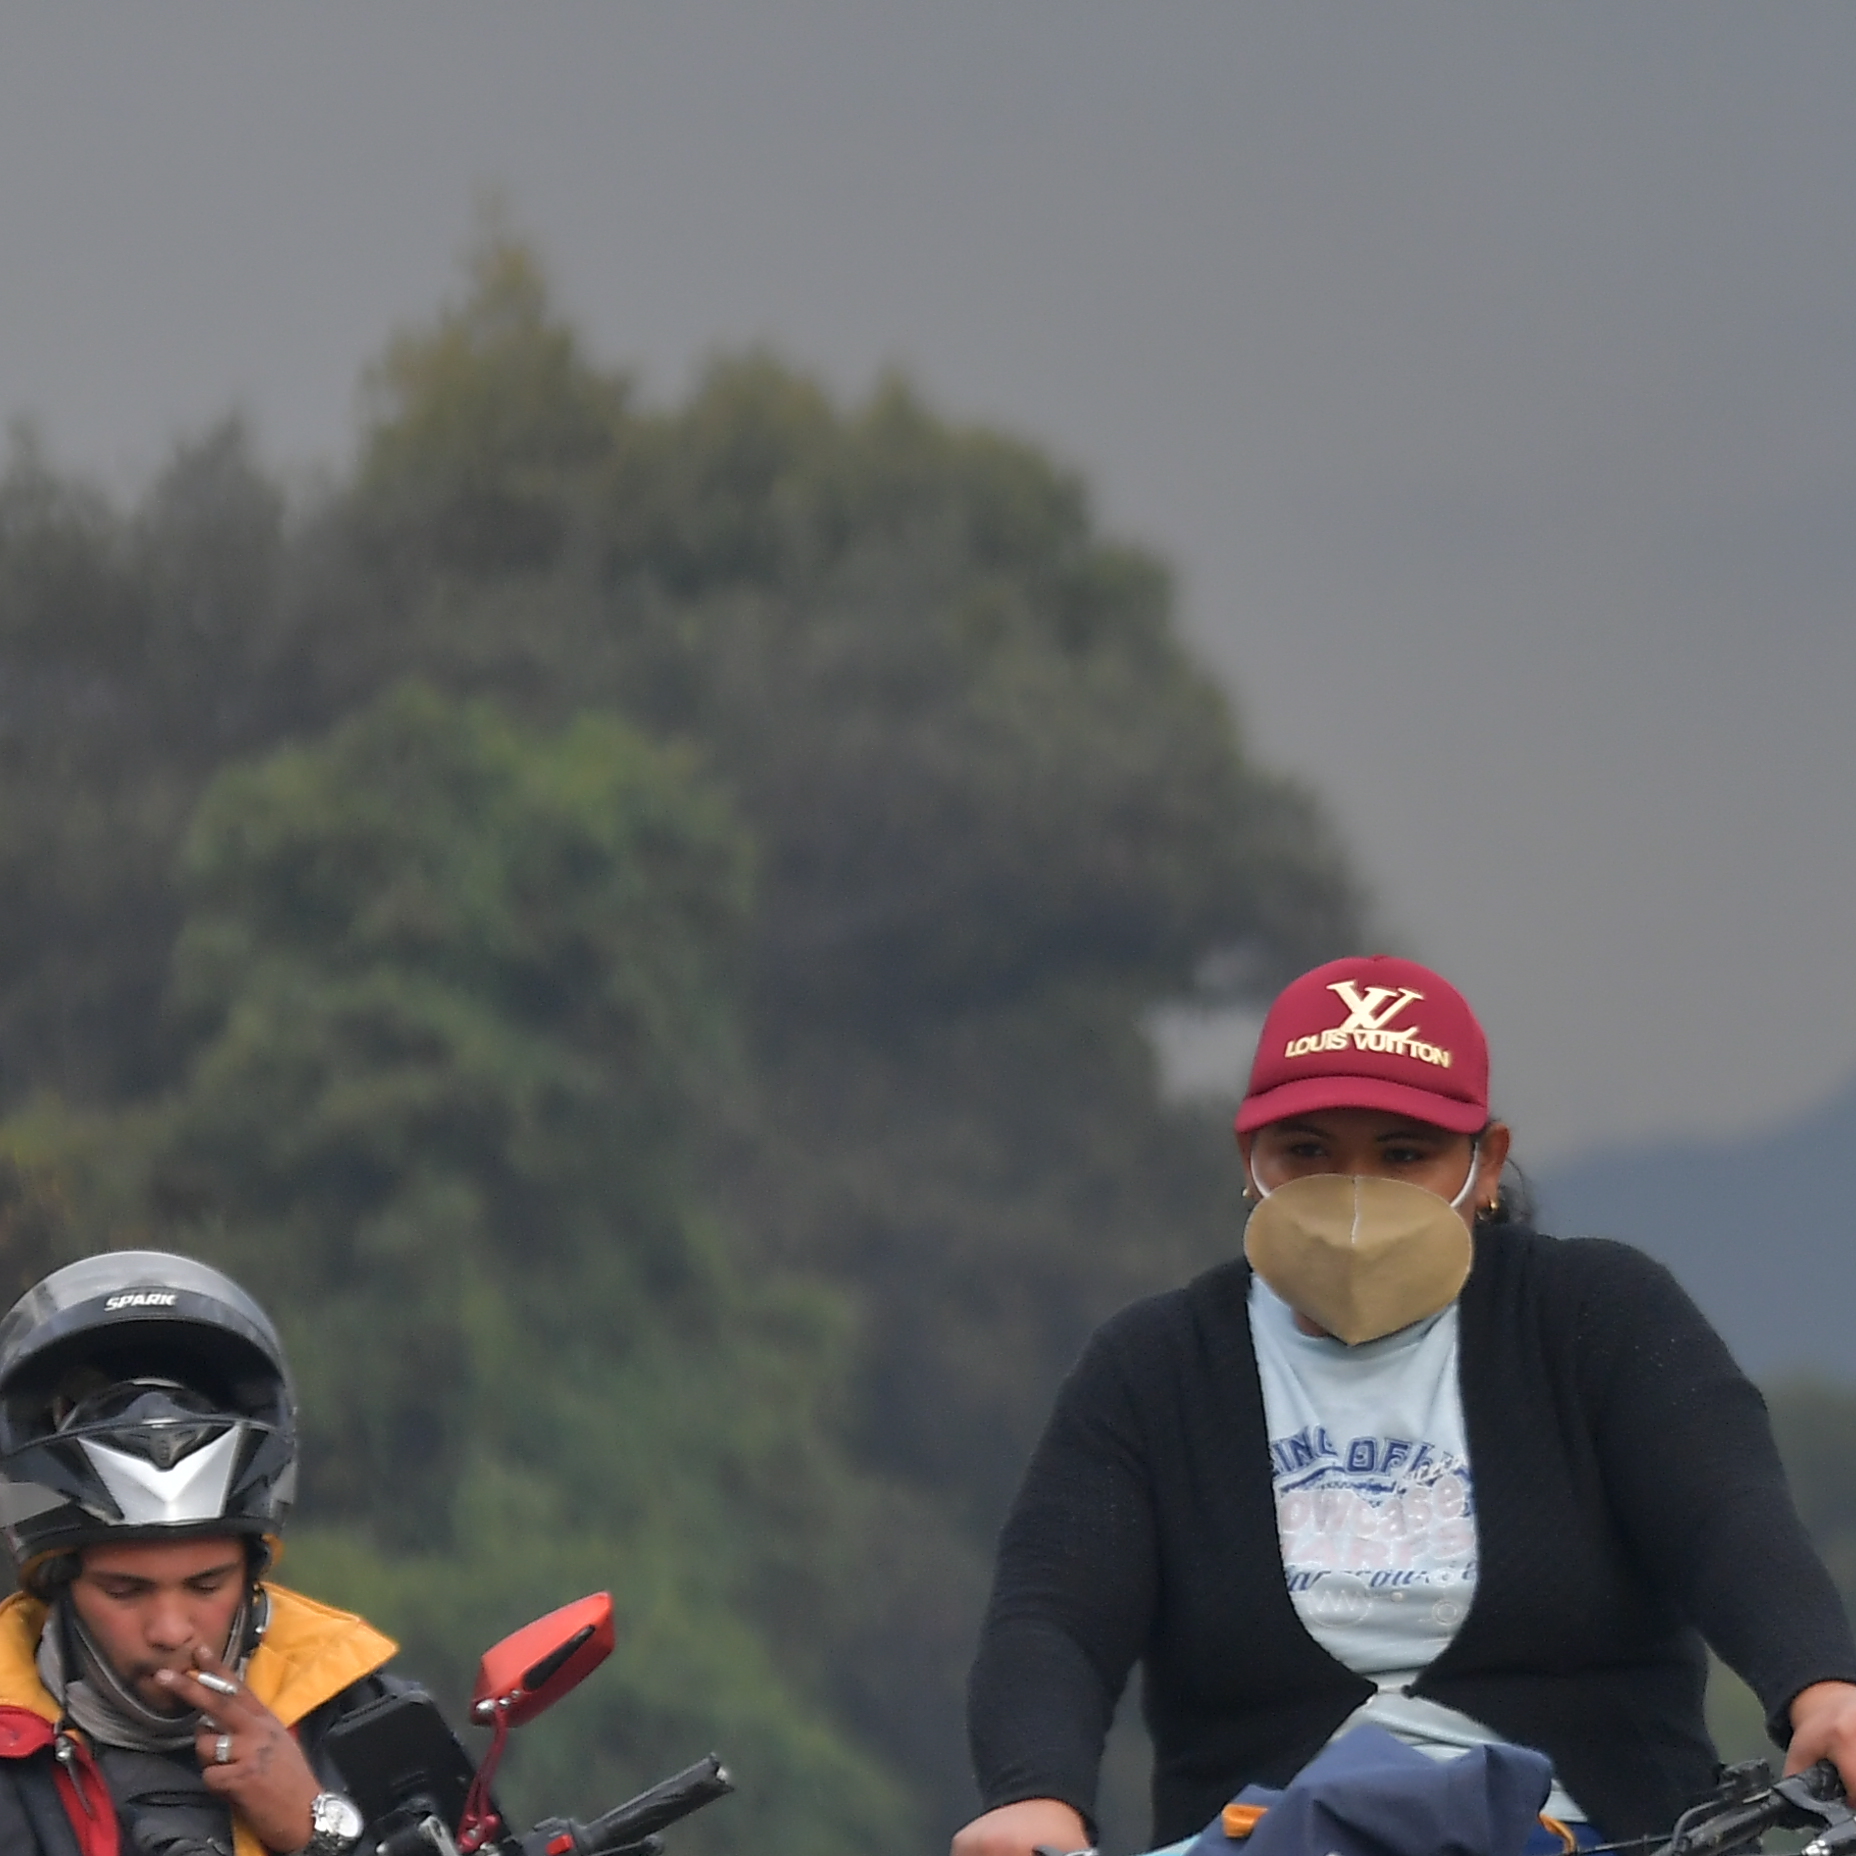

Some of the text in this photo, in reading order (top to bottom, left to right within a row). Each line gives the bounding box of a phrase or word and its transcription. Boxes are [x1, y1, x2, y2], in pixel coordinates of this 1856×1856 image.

[1284, 1028, 1452, 1069] LOUIS VUITTON
[104, 1292, 177, 1313] SPARK
